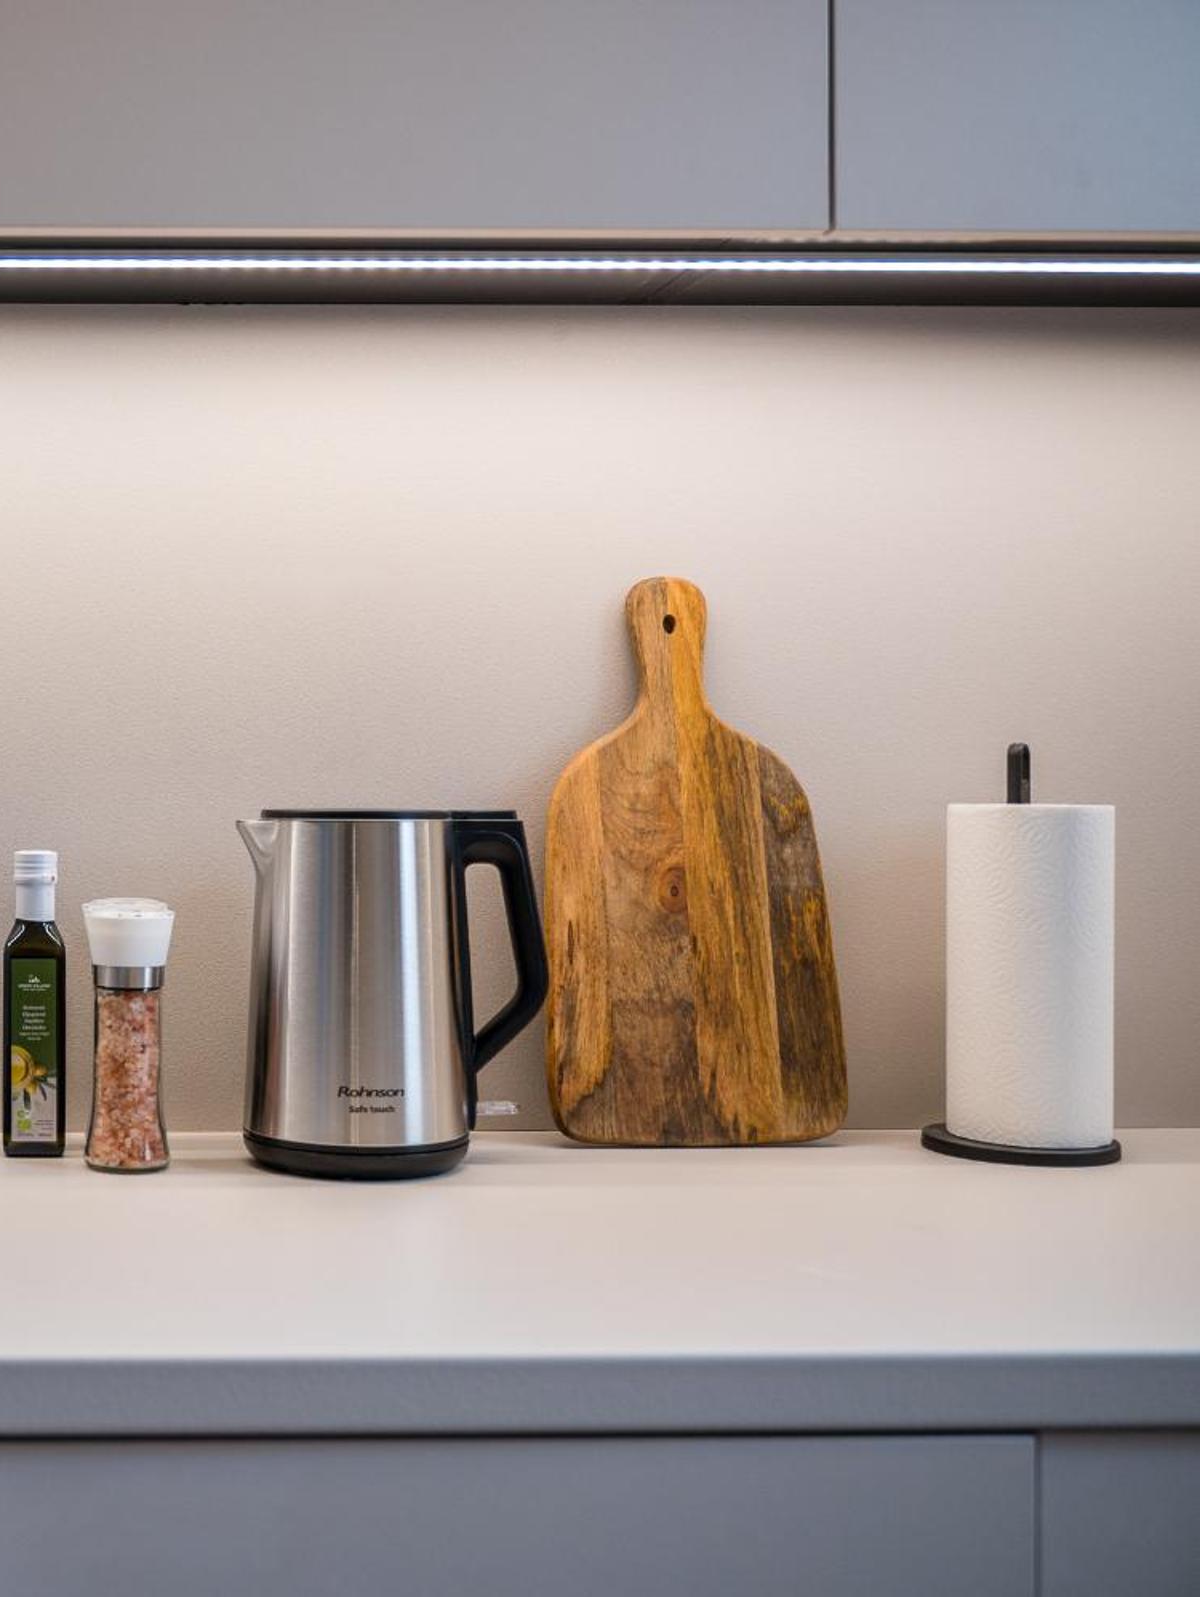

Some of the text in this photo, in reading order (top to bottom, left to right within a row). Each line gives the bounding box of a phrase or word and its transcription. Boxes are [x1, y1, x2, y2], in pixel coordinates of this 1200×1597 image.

[337, 1086, 405, 1097] Rohnson
[348, 1105, 395, 1113] Safe touch
